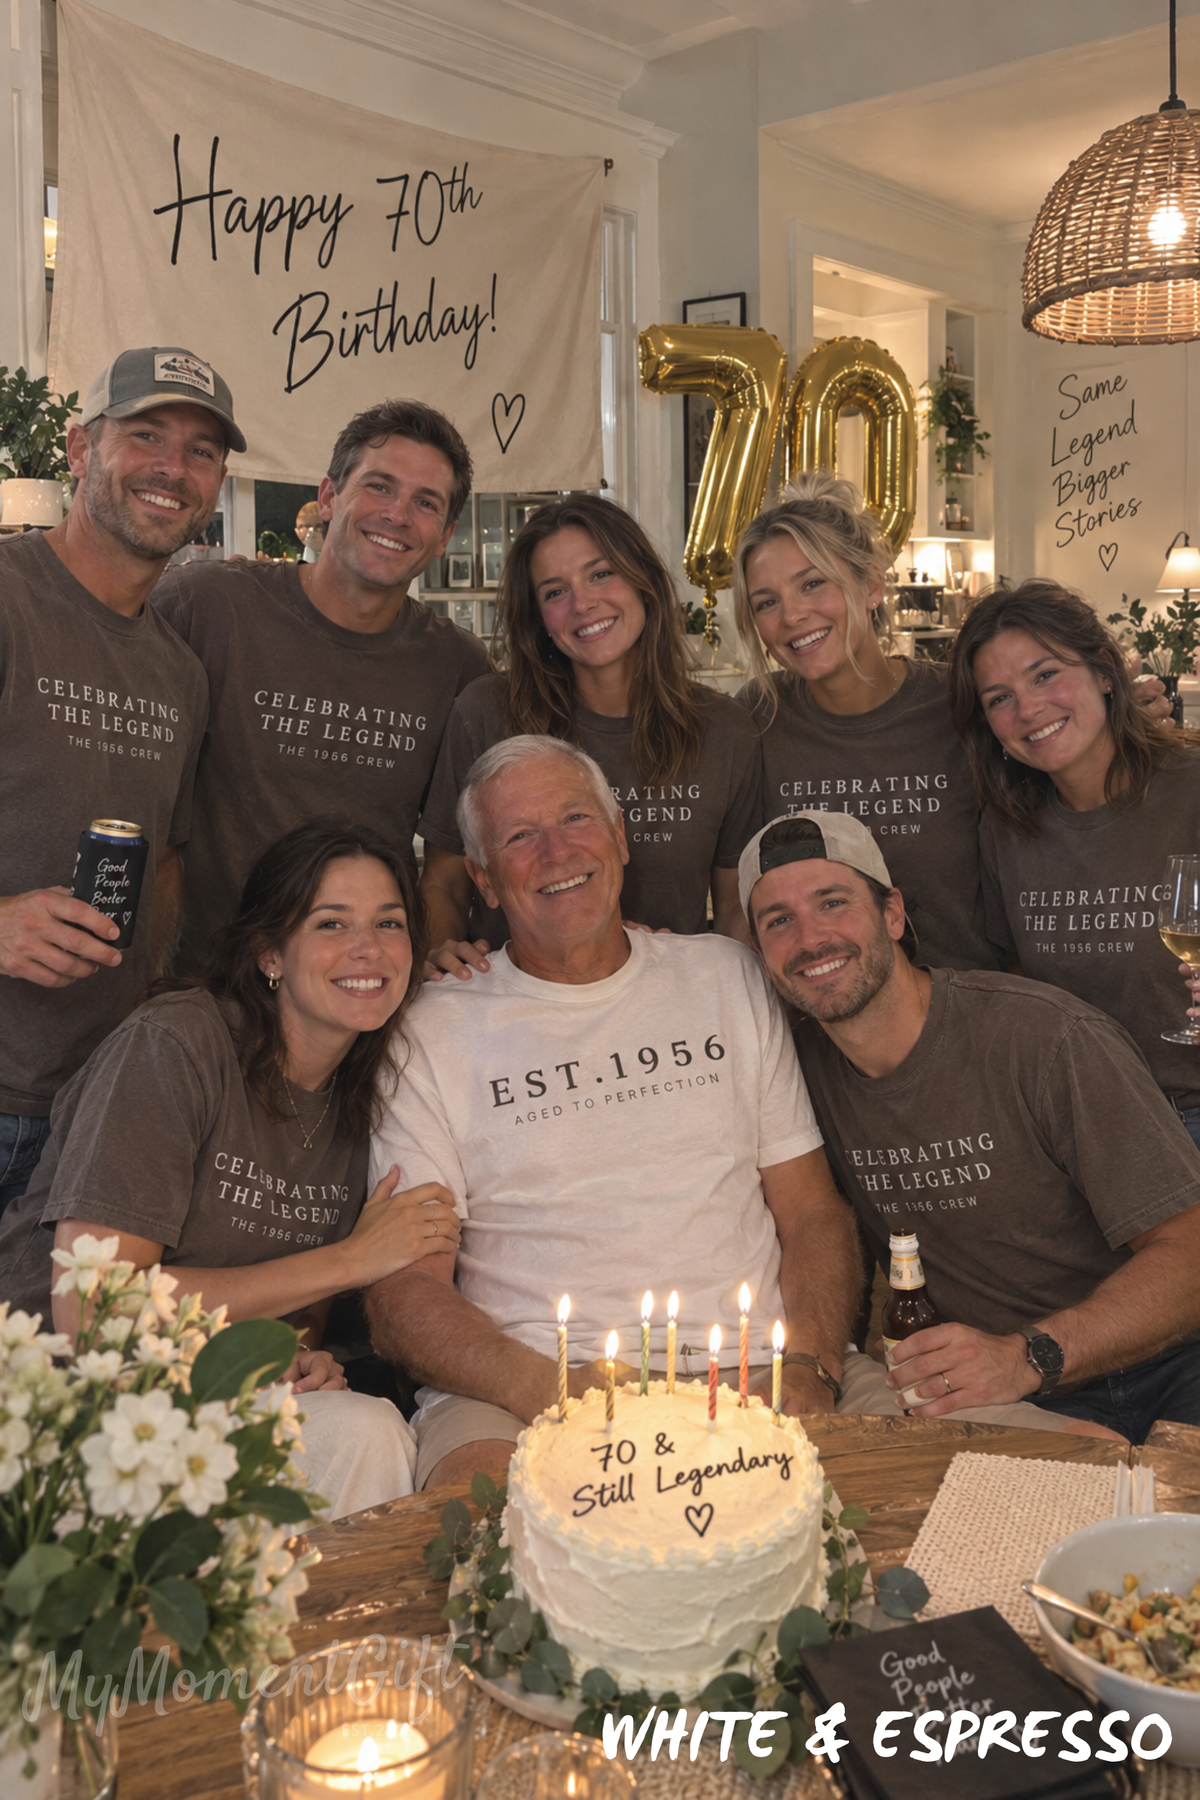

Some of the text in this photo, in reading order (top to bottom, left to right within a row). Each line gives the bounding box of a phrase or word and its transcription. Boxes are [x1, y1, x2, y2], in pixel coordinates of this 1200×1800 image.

[154, 133, 483, 275] Happy 70th
[273, 273, 497, 393] Birthday!
[1058, 373, 1128, 420] Same
[1051, 399, 1138, 467] Legend
[638, 322, 918, 590] 70
[1052, 461, 1131, 507] Bigger
[1055, 498, 1143, 548] Stories
[37, 677, 179, 723] CELEBRATING
[254, 690, 427, 731] CELEBRATING
[47, 703, 174, 743] THE LEGEND
[261, 713, 416, 752] THE LEGEND
[67, 735, 161, 761] THE 1956 CREW
[278, 743, 306, 757] THE
[356, 755, 396, 769] CREW
[610, 784, 700, 801] RATING
[779, 774, 948, 797] CELEBRATING
[621, 806, 692, 822] GEND
[843, 797, 940, 816] LEGEND
[633, 832, 673, 843] CREW
[880, 824, 921, 835] CREW
[94, 873, 131, 892] People
[97, 858, 129, 873] Good
[1024, 911, 1155, 931] THE LEGEND
[1036, 942, 1134, 953] THE 1956 CREW
[489, 1034, 726, 1108] EST.1956
[514, 1073, 720, 1126] AGED TO PERFECTION
[214, 1152, 349, 1202] CELEBRATING
[856, 1162, 991, 1191] THE LEGEND
[218, 1180, 340, 1225] THE LEGEND
[874, 1202, 899, 1214] THE
[939, 1196, 977, 1210] CREW
[231, 1216, 256, 1233] THE
[590, 1432, 675, 1472] 70 &
[572, 1446, 794, 1517] Still Legendary
[880, 1640, 947, 1677] Good
[890, 1664, 975, 1706] People
